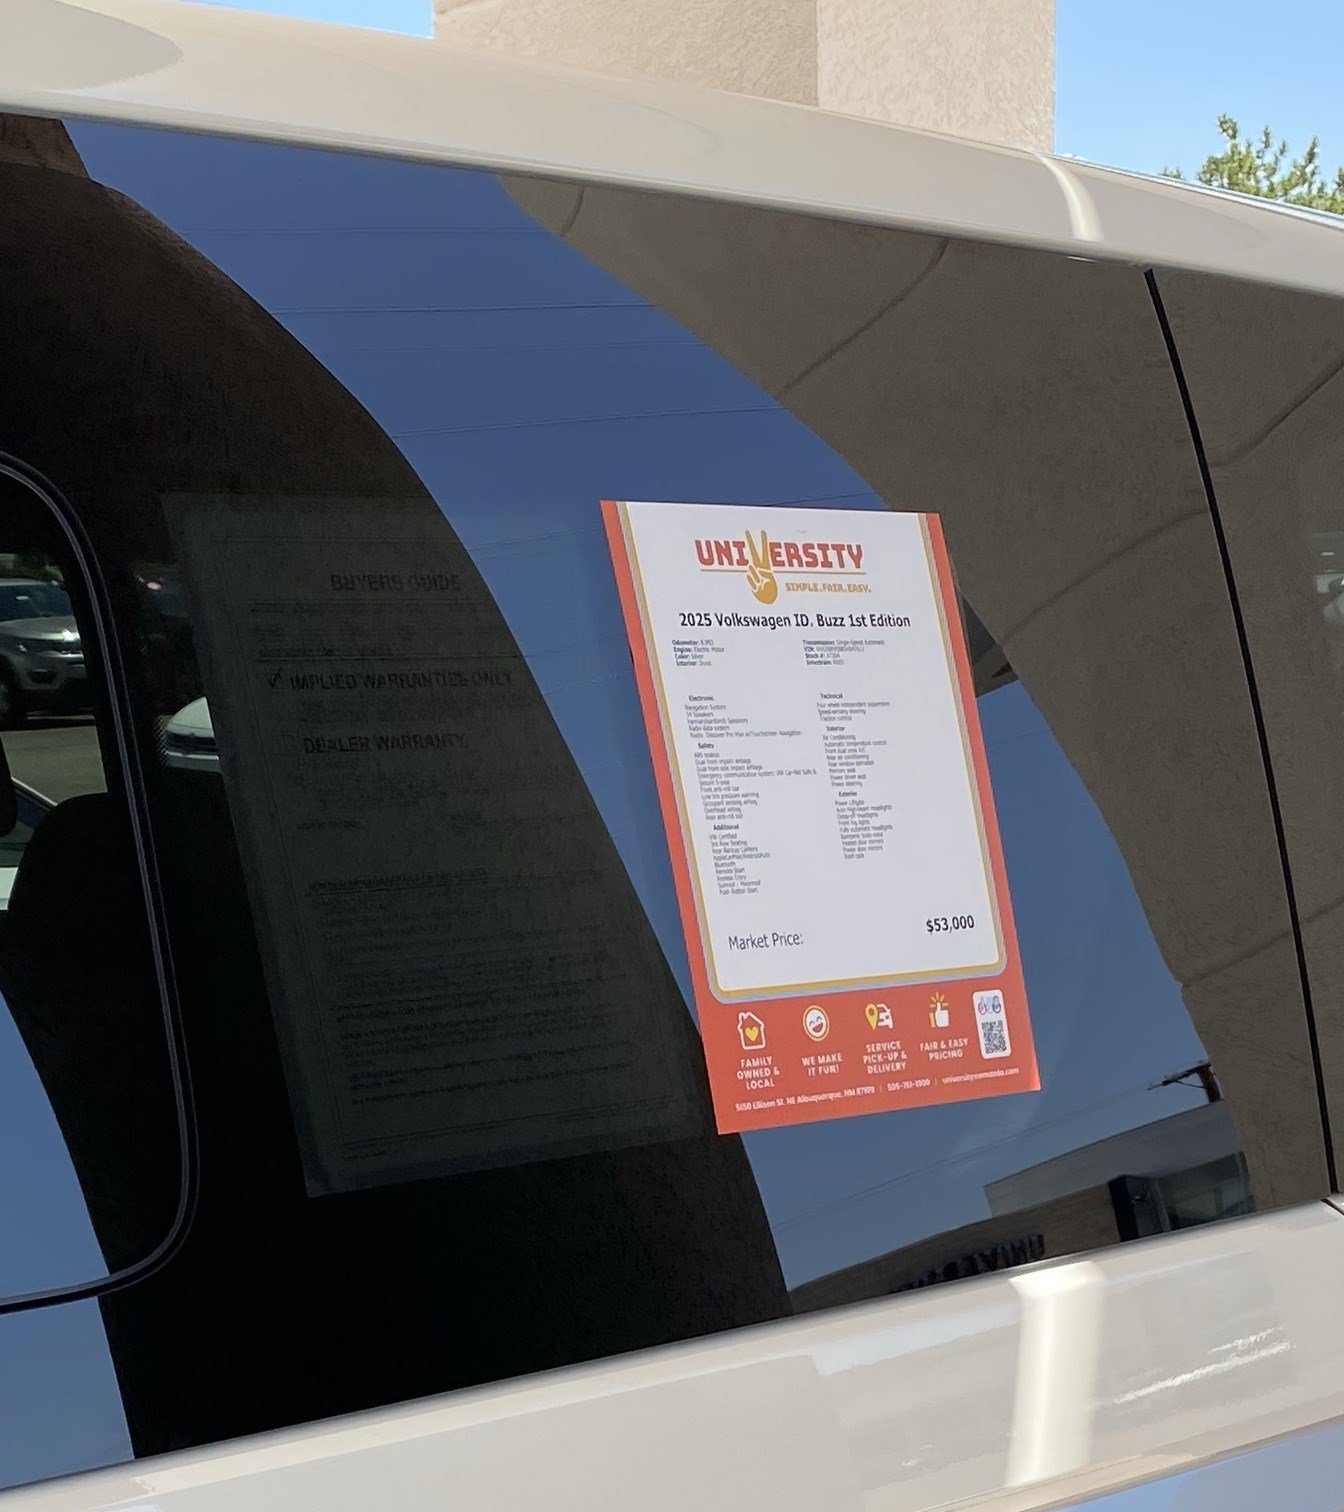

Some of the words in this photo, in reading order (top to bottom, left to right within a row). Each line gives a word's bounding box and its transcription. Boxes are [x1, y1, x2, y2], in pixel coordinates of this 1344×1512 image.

[694, 530, 863, 568] UNIVERSITY
[330, 573, 403, 591] BUYERS
[408, 573, 461, 591] GUIDE
[678, 612, 712, 627] 2025
[715, 613, 791, 630] Volkswagen
[794, 614, 815, 628] ID.
[817, 614, 845, 628] Buzz
[849, 614, 868, 628] 1st
[871, 614, 911, 628] Edition
[290, 674, 357, 691] IMPLIED
[304, 736, 370, 754] DEALER
[925, 914, 975, 935] $53,000
[728, 934, 769, 951] Market
[772, 931, 803, 947] Price:
[866, 1040, 901, 1052] SERVICE
[919, 1042, 938, 1051] FAIR
[948, 1037, 968, 1047] EASY
[740, 1056, 772, 1068] FAMILY
[801, 1057, 815, 1067] WE
[818, 1053, 843, 1064] MAKE
[863, 1053, 898, 1064] PICK-UP
[928, 1050, 963, 1061] PRICING
[737, 1067, 771, 1080] OWNED
[807, 1066, 816, 1076] IT
[818, 1064, 839, 1075] FUN!
[867, 1061, 906, 1075] DELIVERY
[746, 1078, 775, 1090] LOCAL
